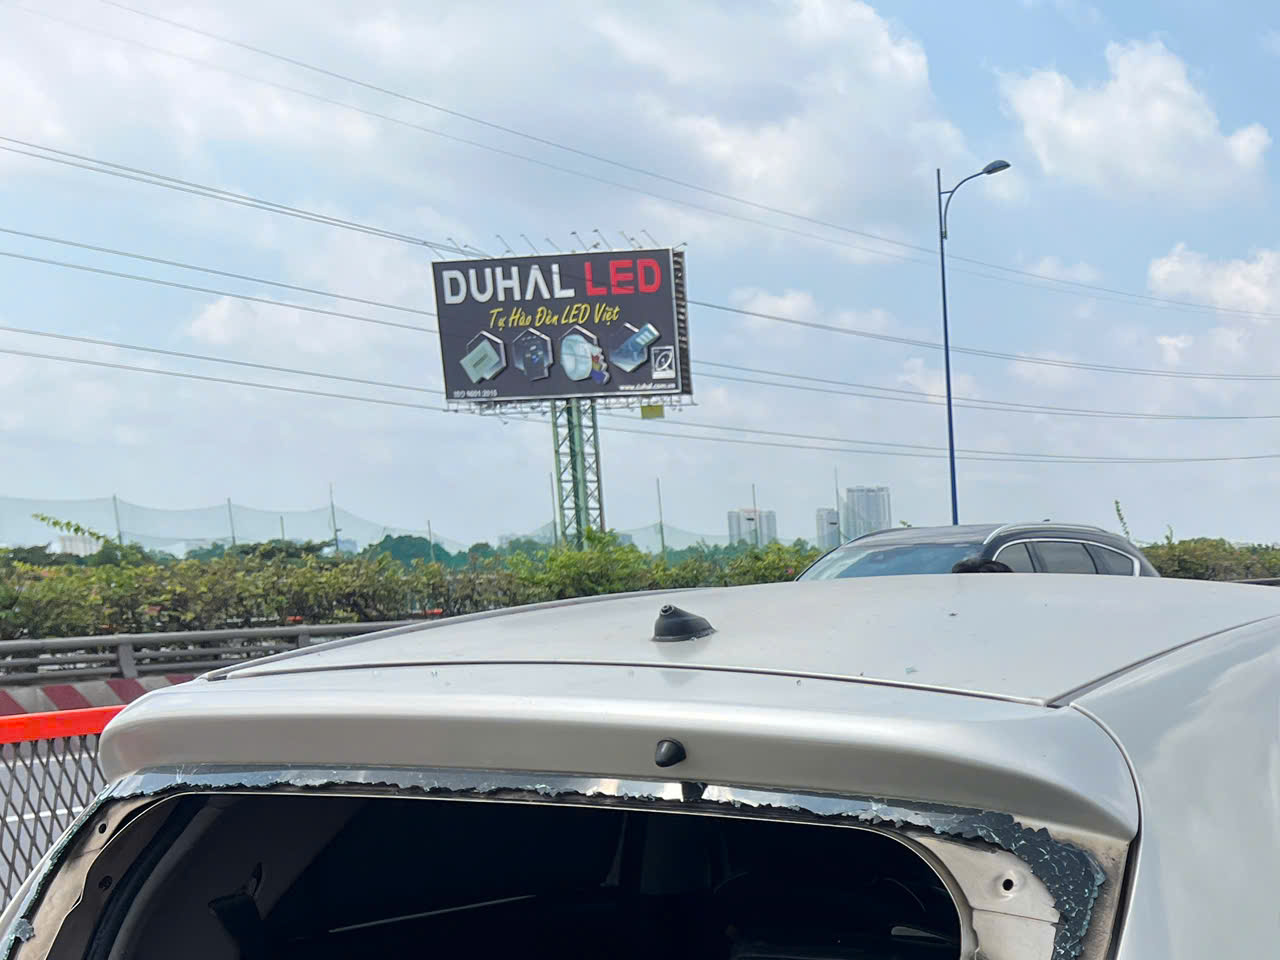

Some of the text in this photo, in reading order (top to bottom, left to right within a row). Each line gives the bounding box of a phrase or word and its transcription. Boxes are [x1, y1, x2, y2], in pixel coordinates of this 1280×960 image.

[442, 258, 663, 304] DUHAL LED
[561, 303, 591, 324] LED
[594, 302, 620, 325] Việt
